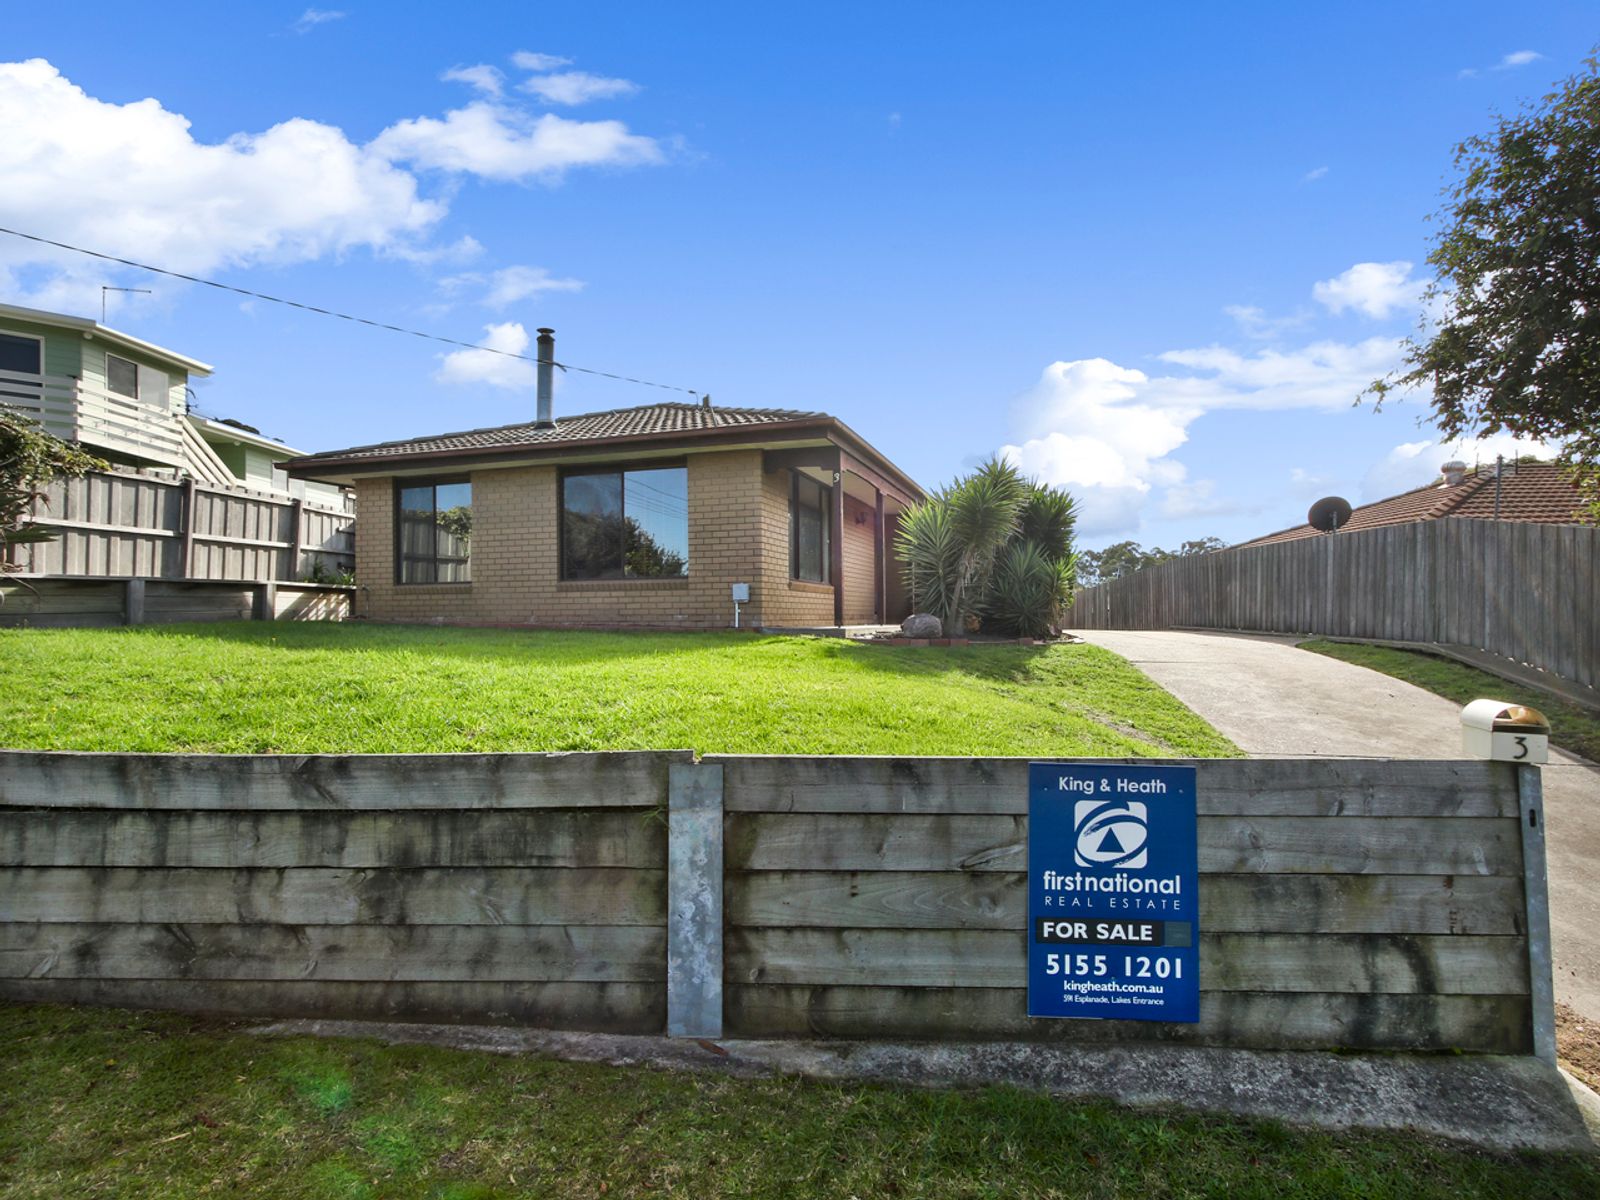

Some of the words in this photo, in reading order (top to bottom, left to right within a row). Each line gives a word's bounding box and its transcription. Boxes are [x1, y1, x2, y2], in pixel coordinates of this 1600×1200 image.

[1513, 736, 1528, 759] 3
[1058, 776, 1095, 795] King
[1099, 779, 1111, 792] &
[1117, 778, 1167, 793] Heath
[1044, 896, 1093, 908] REAL
[1109, 897, 1181, 910] ESTATE
[1043, 922, 1089, 939] FOR
[1096, 923, 1153, 941] SALE
[1046, 954, 1107, 976] 5155
[1124, 956, 1182, 979] 1201
[1063, 979, 1163, 994] kingheath.com.au
[1111, 996, 1131, 1004] Lakes
[1132, 996, 1165, 1006] Entrance
